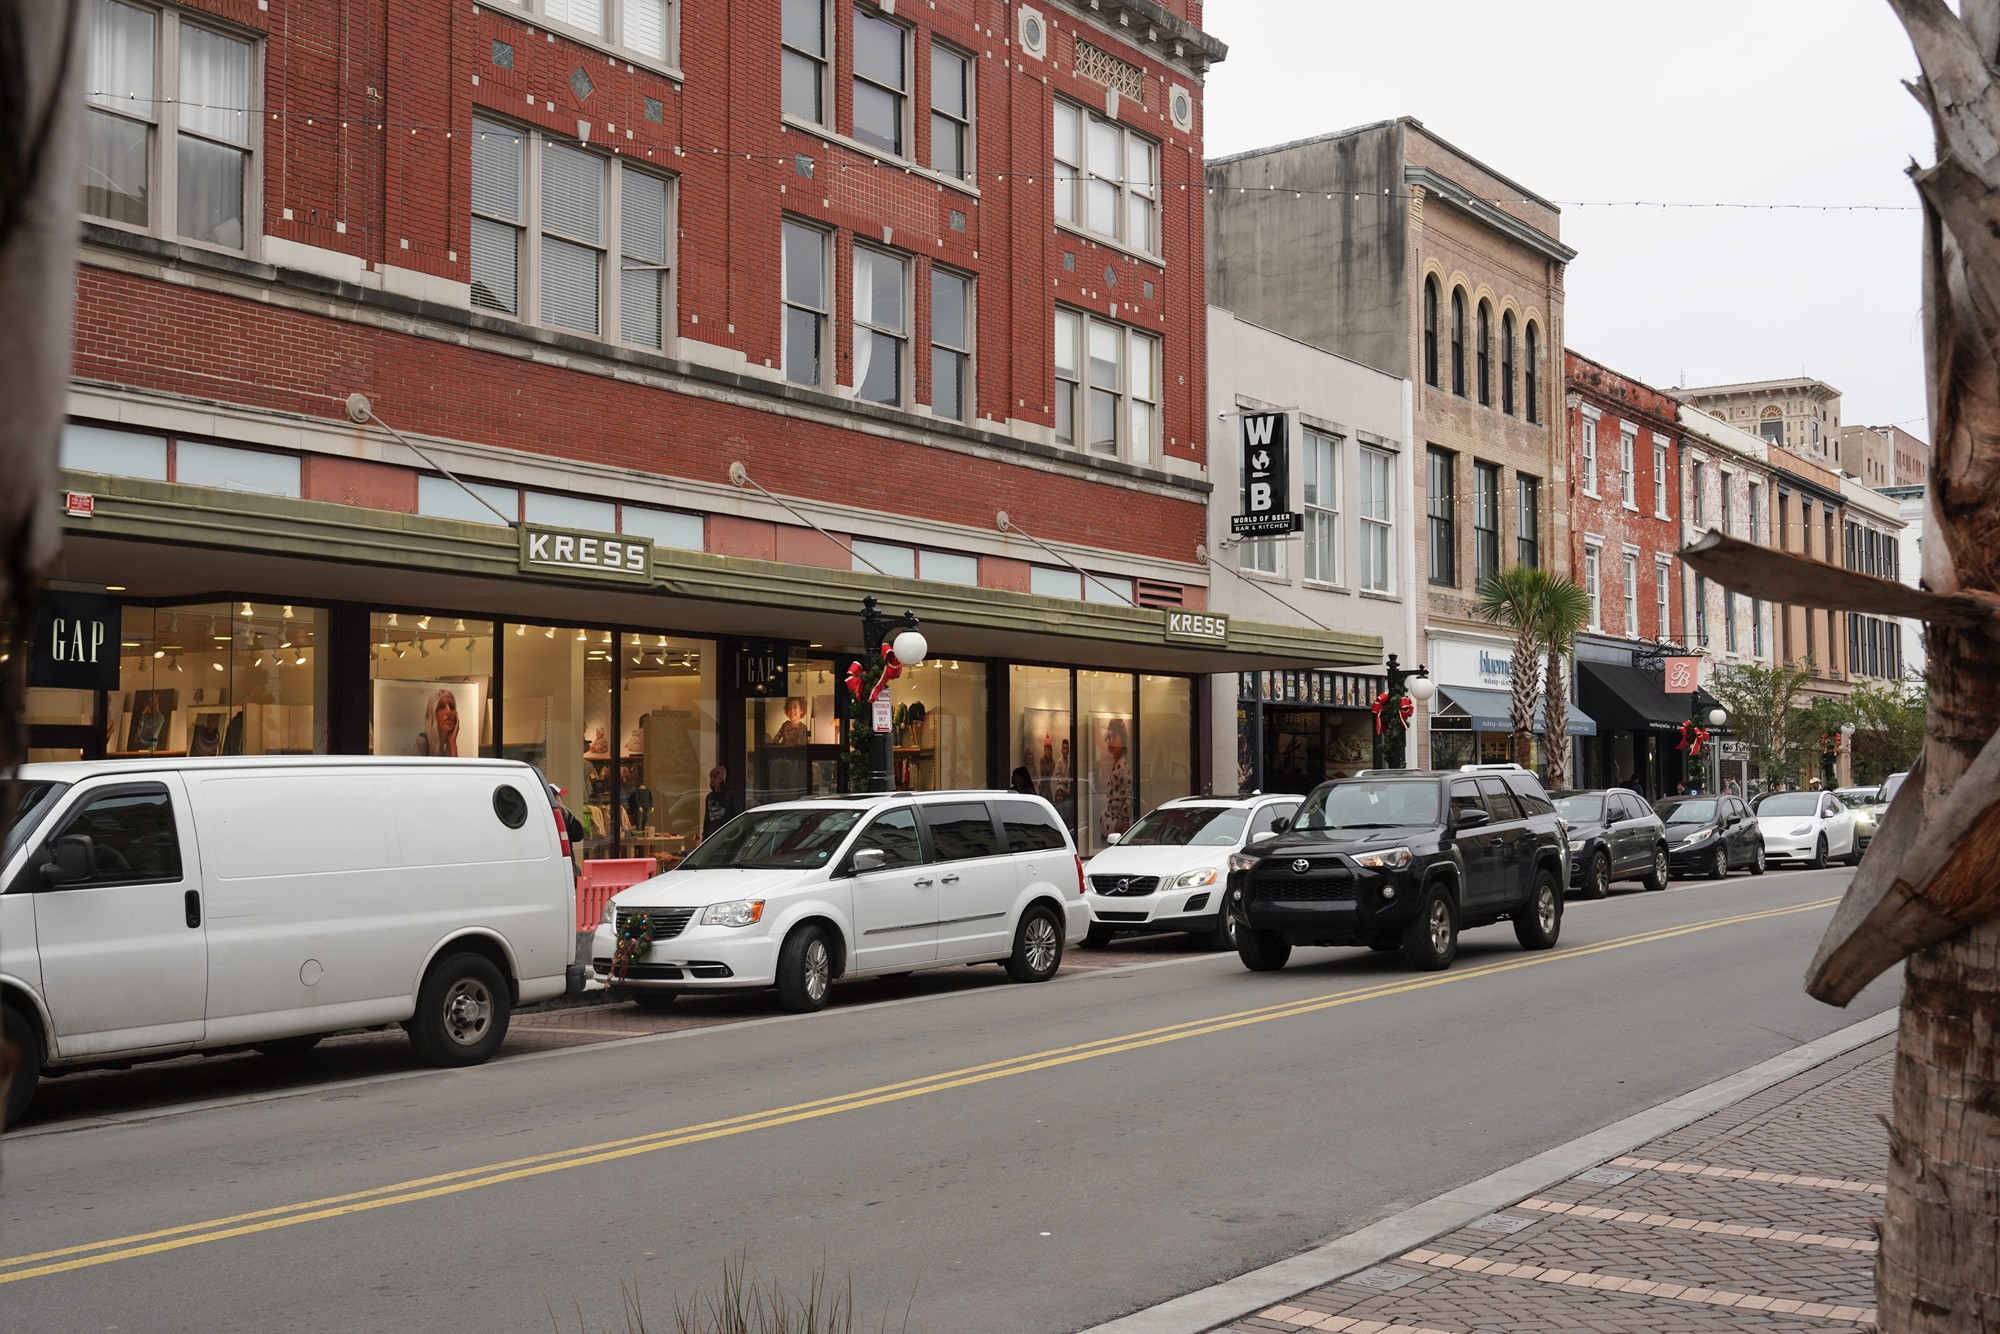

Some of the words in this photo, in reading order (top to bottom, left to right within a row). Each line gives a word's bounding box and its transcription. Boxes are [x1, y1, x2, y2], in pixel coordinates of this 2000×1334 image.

[1233, 515, 1258, 524] WORLD
[1271, 513, 1290, 521] BEER
[529, 533, 645, 571] KRESS
[1170, 613, 1225, 637] KRESS
[52, 617, 105, 663] GAP
[747, 656, 775, 683] GAP
[1359, 1269, 1409, 1288] 1509
